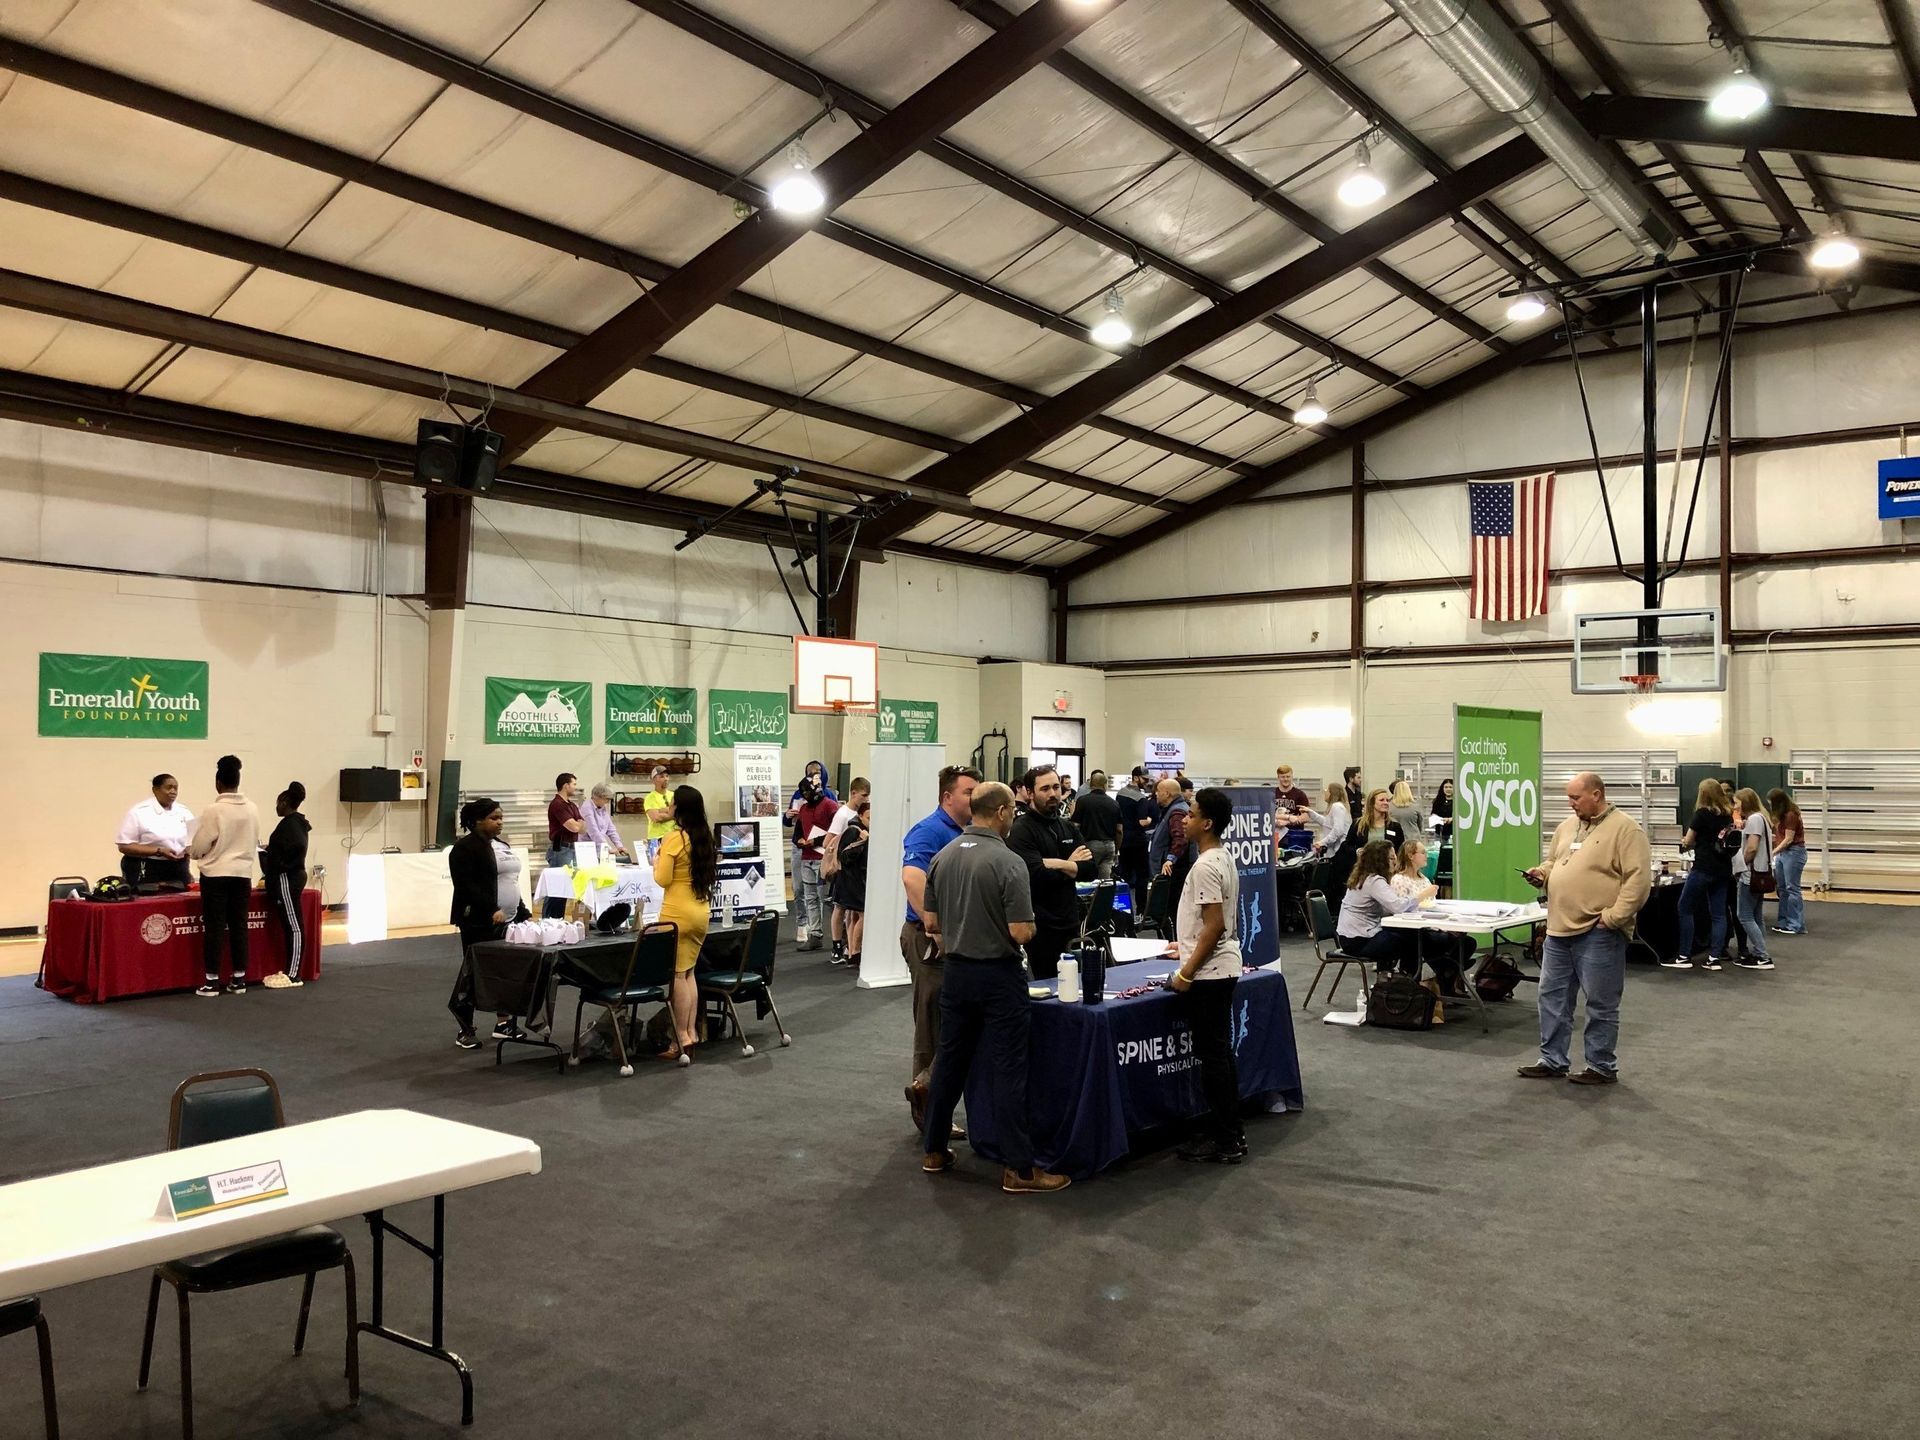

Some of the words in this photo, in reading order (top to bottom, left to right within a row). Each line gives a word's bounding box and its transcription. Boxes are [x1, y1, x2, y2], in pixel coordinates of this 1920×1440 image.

[48, 688, 135, 709] Emerald
[144, 692, 201, 711] Youth
[63, 710, 189, 722] FOUNDATION
[505, 711, 559, 722] FOOTHILLS
[609, 707, 657, 723] Emerald
[663, 710, 694, 724] Youth
[497, 722, 540, 733] PHYSICAL
[541, 724, 582, 733] THERAPY
[629, 726, 678, 735] SPORTS
[1156, 743, 1176, 752] BESCO
[1483, 737, 1507, 758] things
[1459, 761, 1537, 844] Sysco
[1263, 812, 1273, 837] &
[631, 881, 643, 895] SK
[171, 915, 197, 926] CITY
[175, 925, 200, 936] FIRE
[1117, 1036, 1164, 1066] SPINE
[1165, 1034, 1177, 1058] &
[1157, 1059, 1191, 1077] PHYSICAL
[229, 1175, 255, 1187] Hackney
